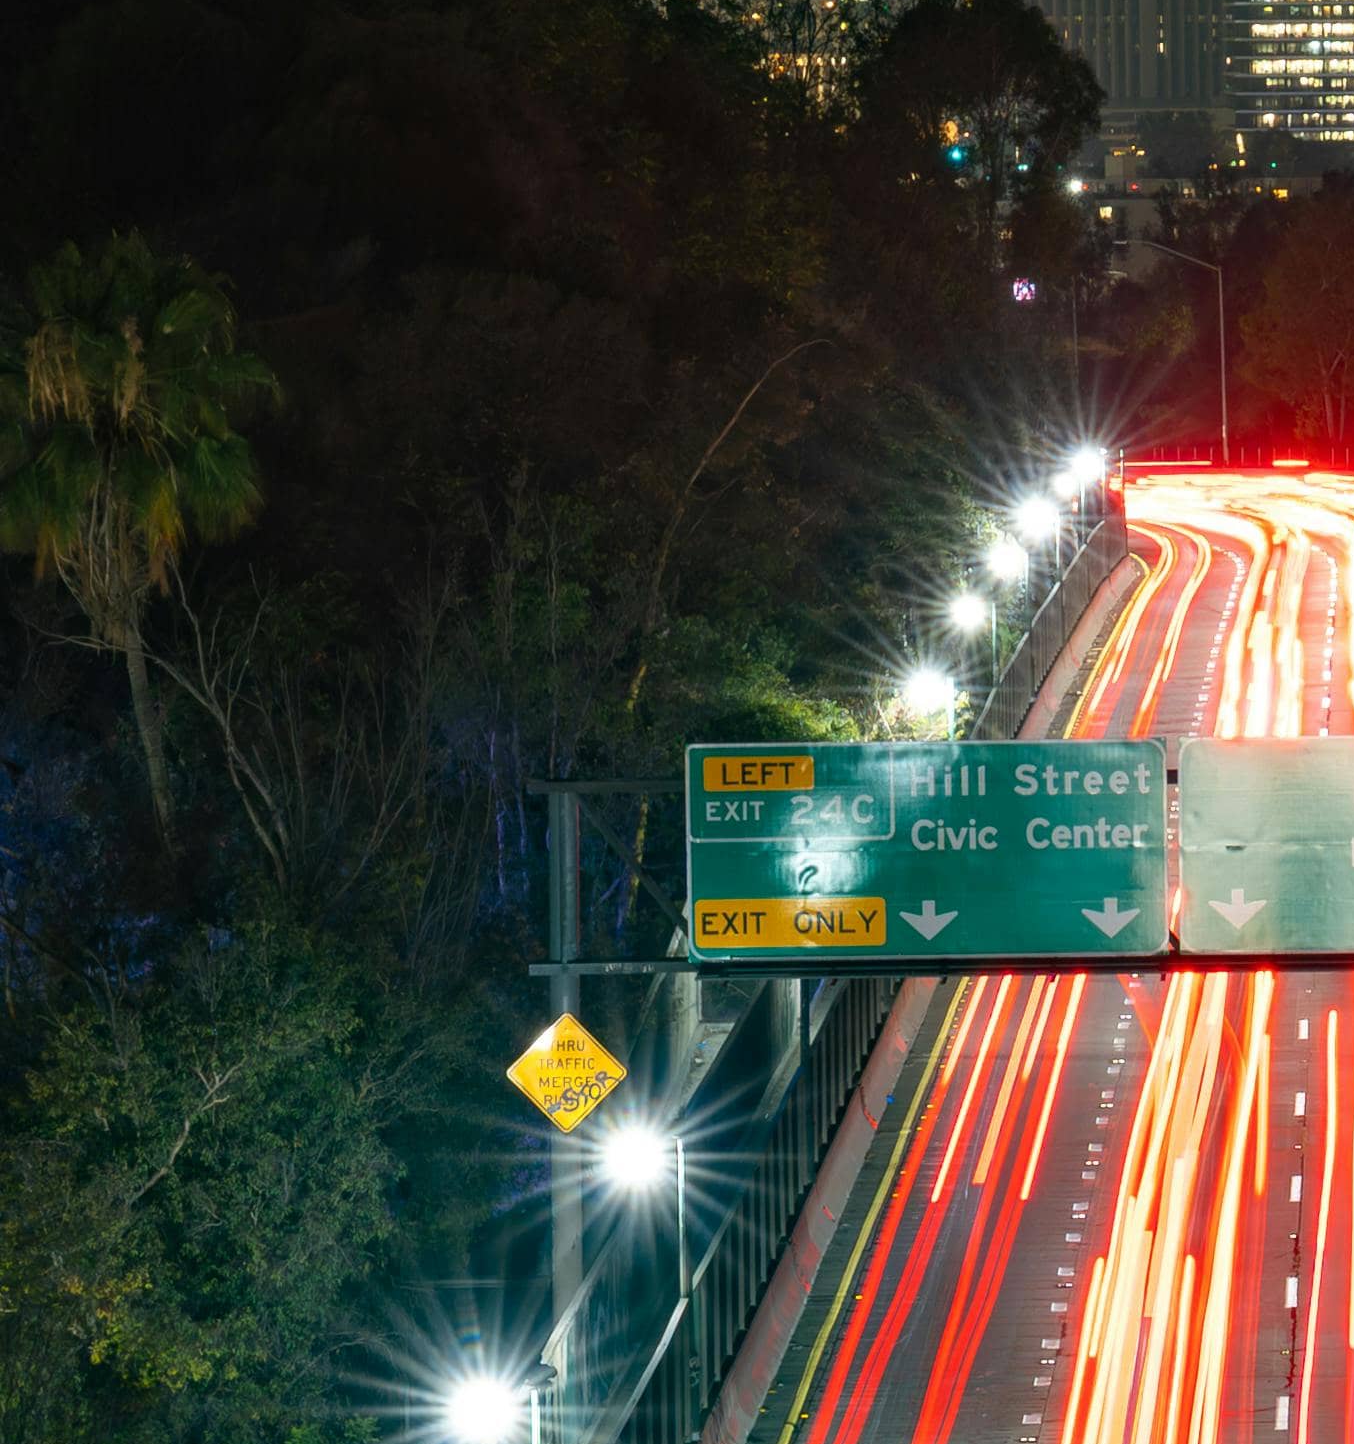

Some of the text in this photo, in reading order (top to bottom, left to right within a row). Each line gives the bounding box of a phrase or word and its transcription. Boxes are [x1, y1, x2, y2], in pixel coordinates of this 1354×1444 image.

[721, 762, 796, 786] LEFT
[910, 762, 1152, 797] Hill Street
[705, 794, 875, 825] EXIT 24C
[910, 817, 1149, 852] Civic Center
[701, 909, 879, 936] EXIT ONLY
[538, 1057, 595, 1070] TRAFFIC
[538, 1076, 593, 1089] MERGE
